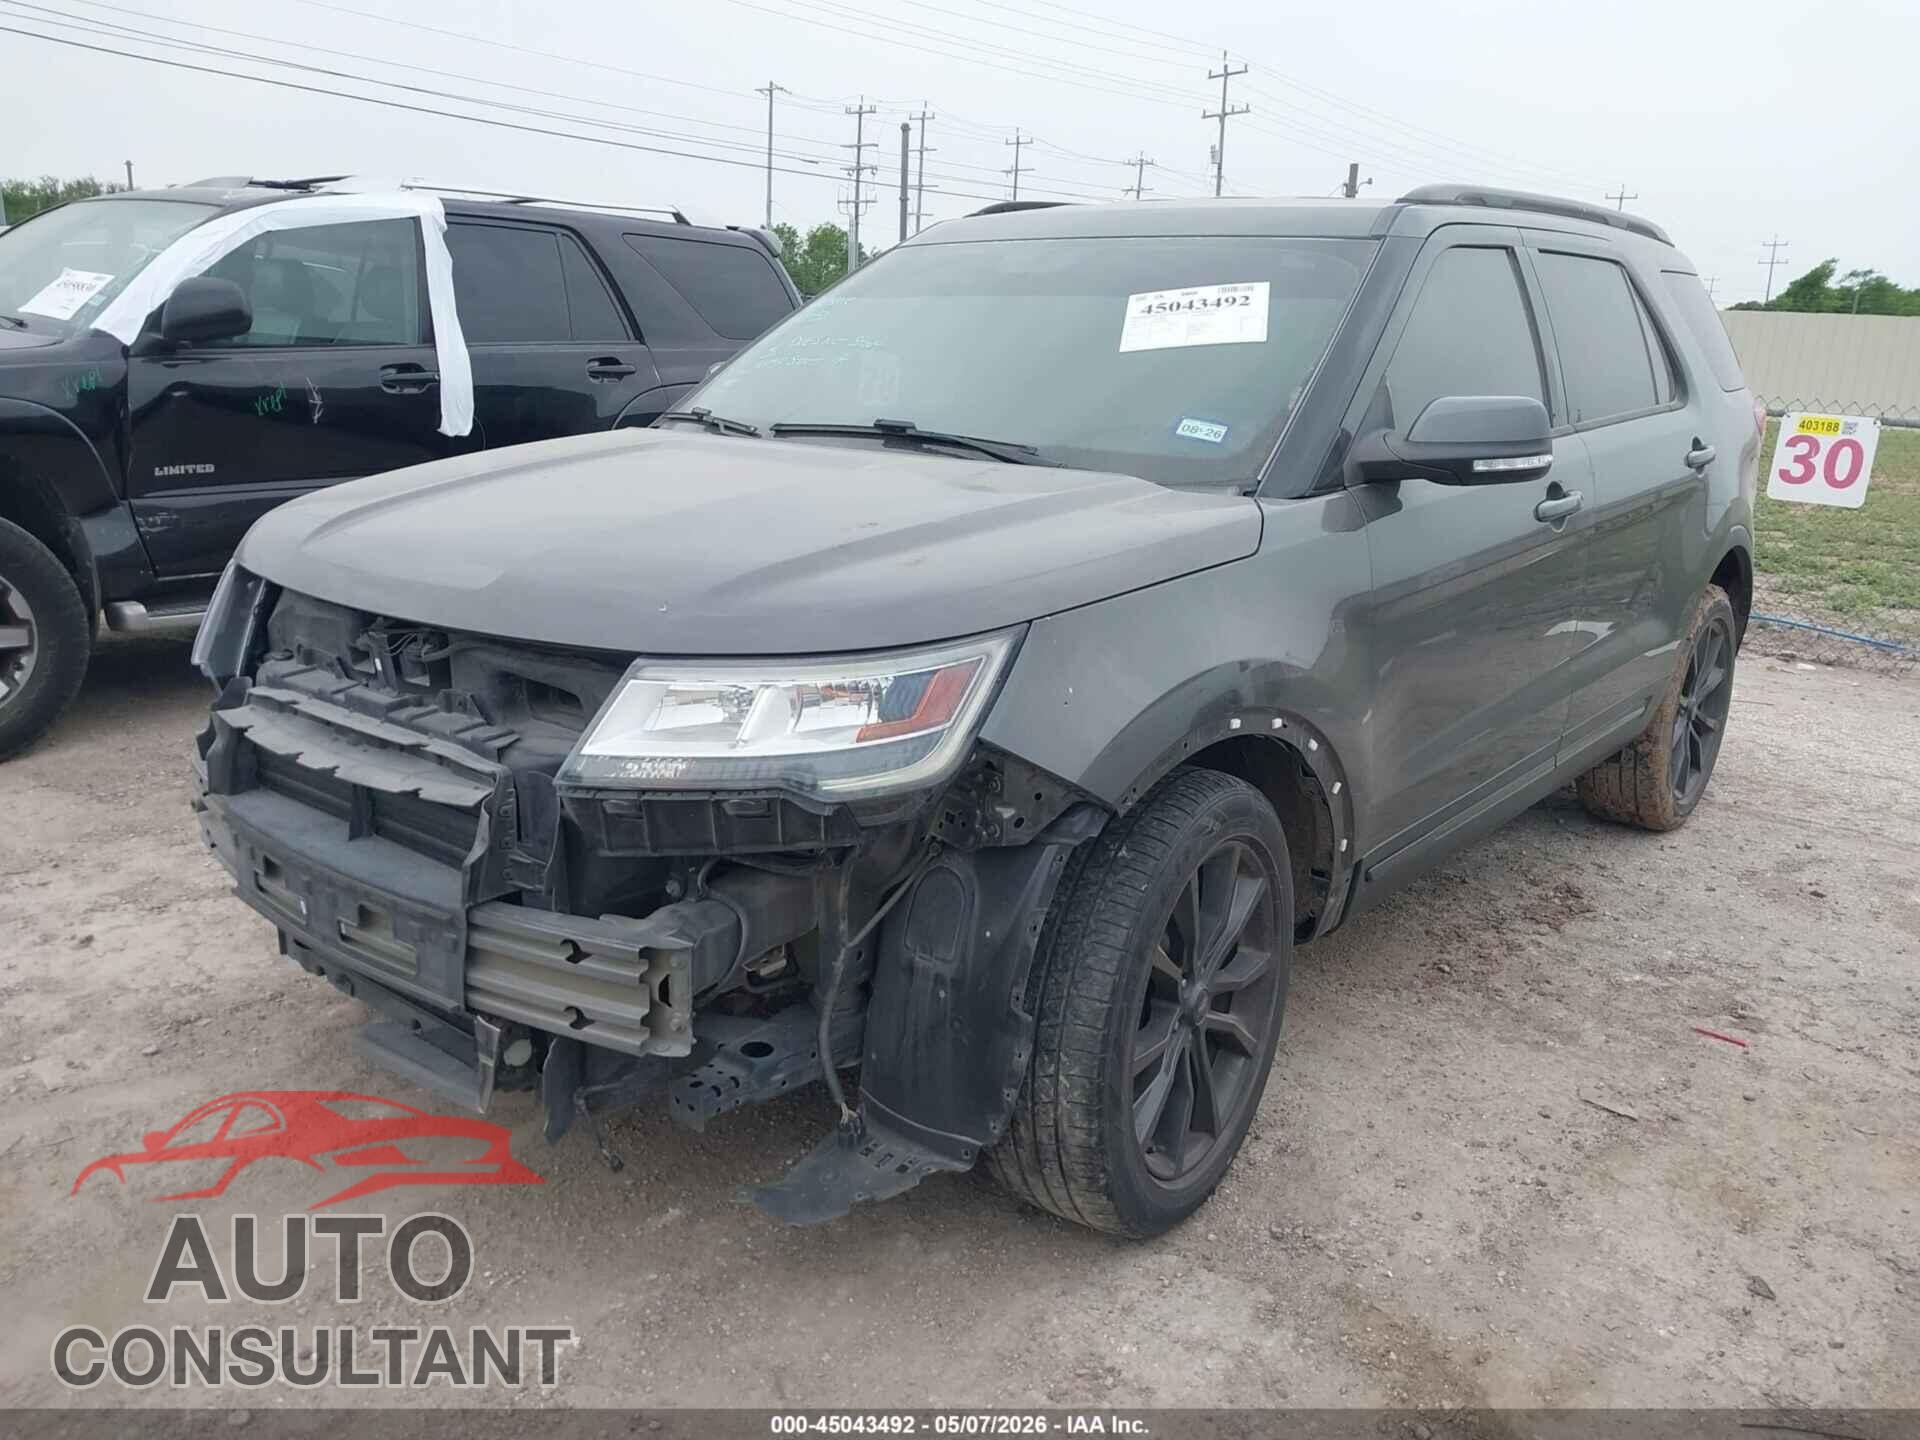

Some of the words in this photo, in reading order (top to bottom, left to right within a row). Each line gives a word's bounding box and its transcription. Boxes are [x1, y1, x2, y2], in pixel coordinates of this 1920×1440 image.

[1140, 295, 1251, 314] 45043492
[1798, 419, 1840, 433] 403188
[154, 463, 215, 476] LIMITED
[1778, 434, 1864, 489] 30
